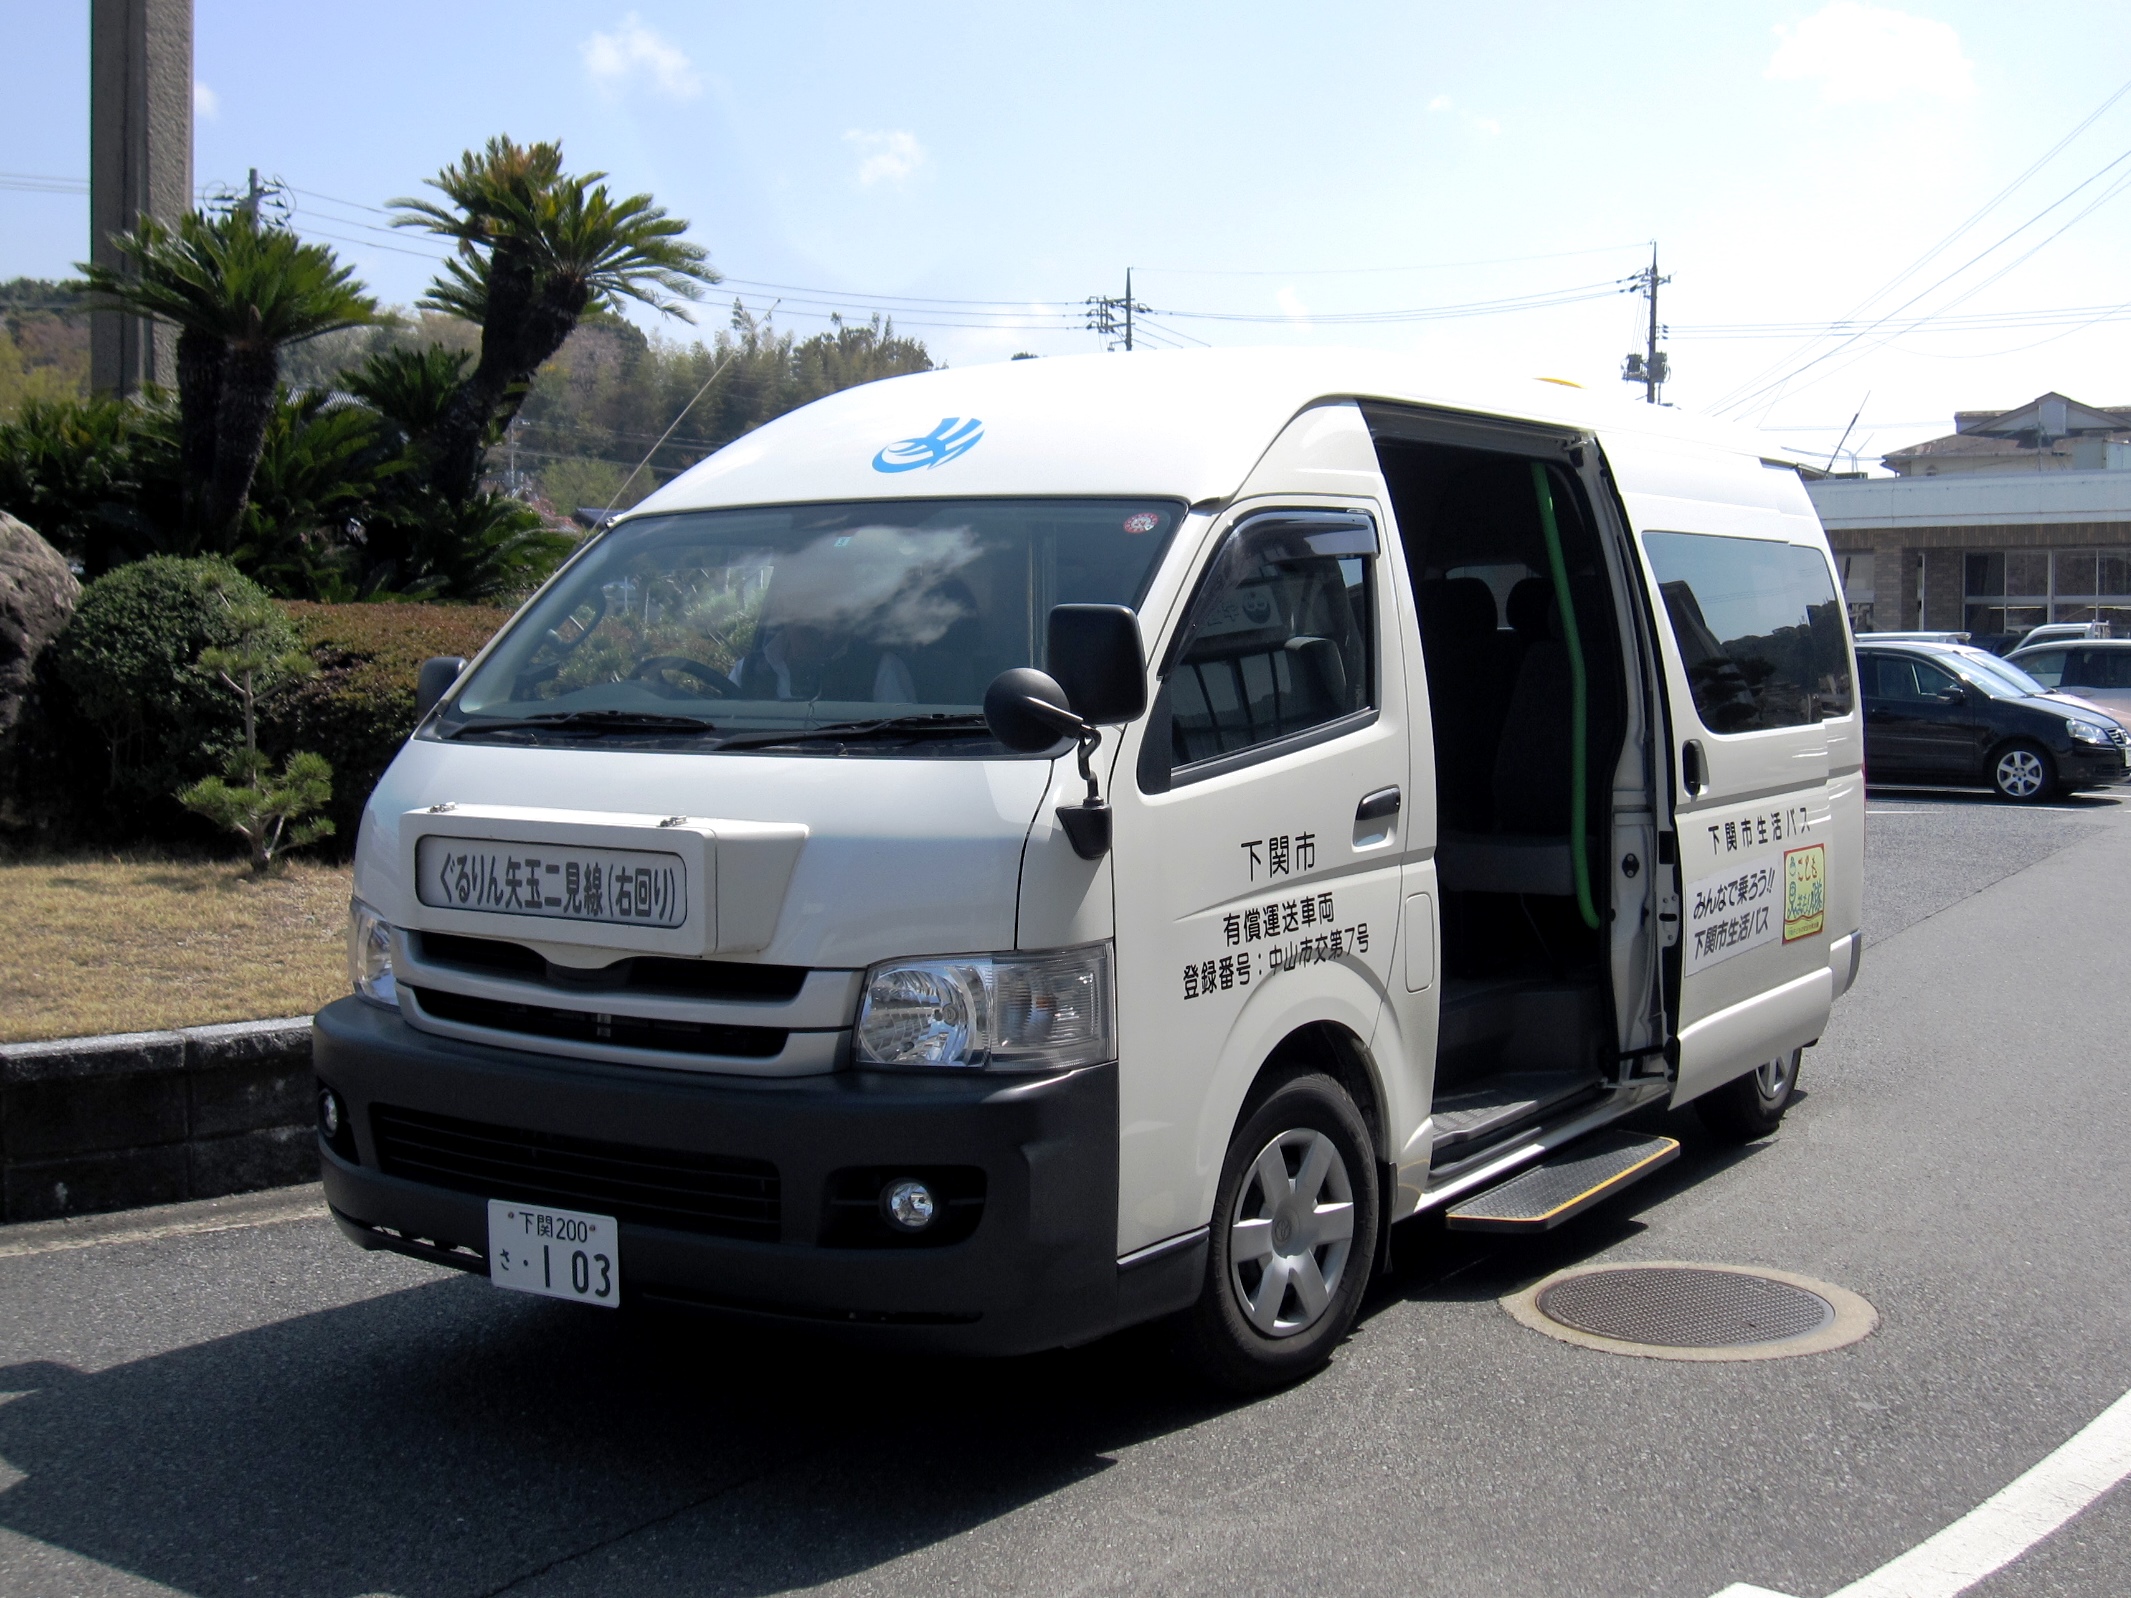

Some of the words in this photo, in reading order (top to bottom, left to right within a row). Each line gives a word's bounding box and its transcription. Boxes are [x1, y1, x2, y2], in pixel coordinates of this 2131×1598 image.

[1240, 831, 1316, 882] 下関市
[1708, 807, 1811, 855] 下関市生活バス
[1222, 891, 1335, 947] 有償運送車両
[1693, 867, 1775, 920] みんなで乗ろう!!
[1694, 906, 1770, 960] 下関市生活バス
